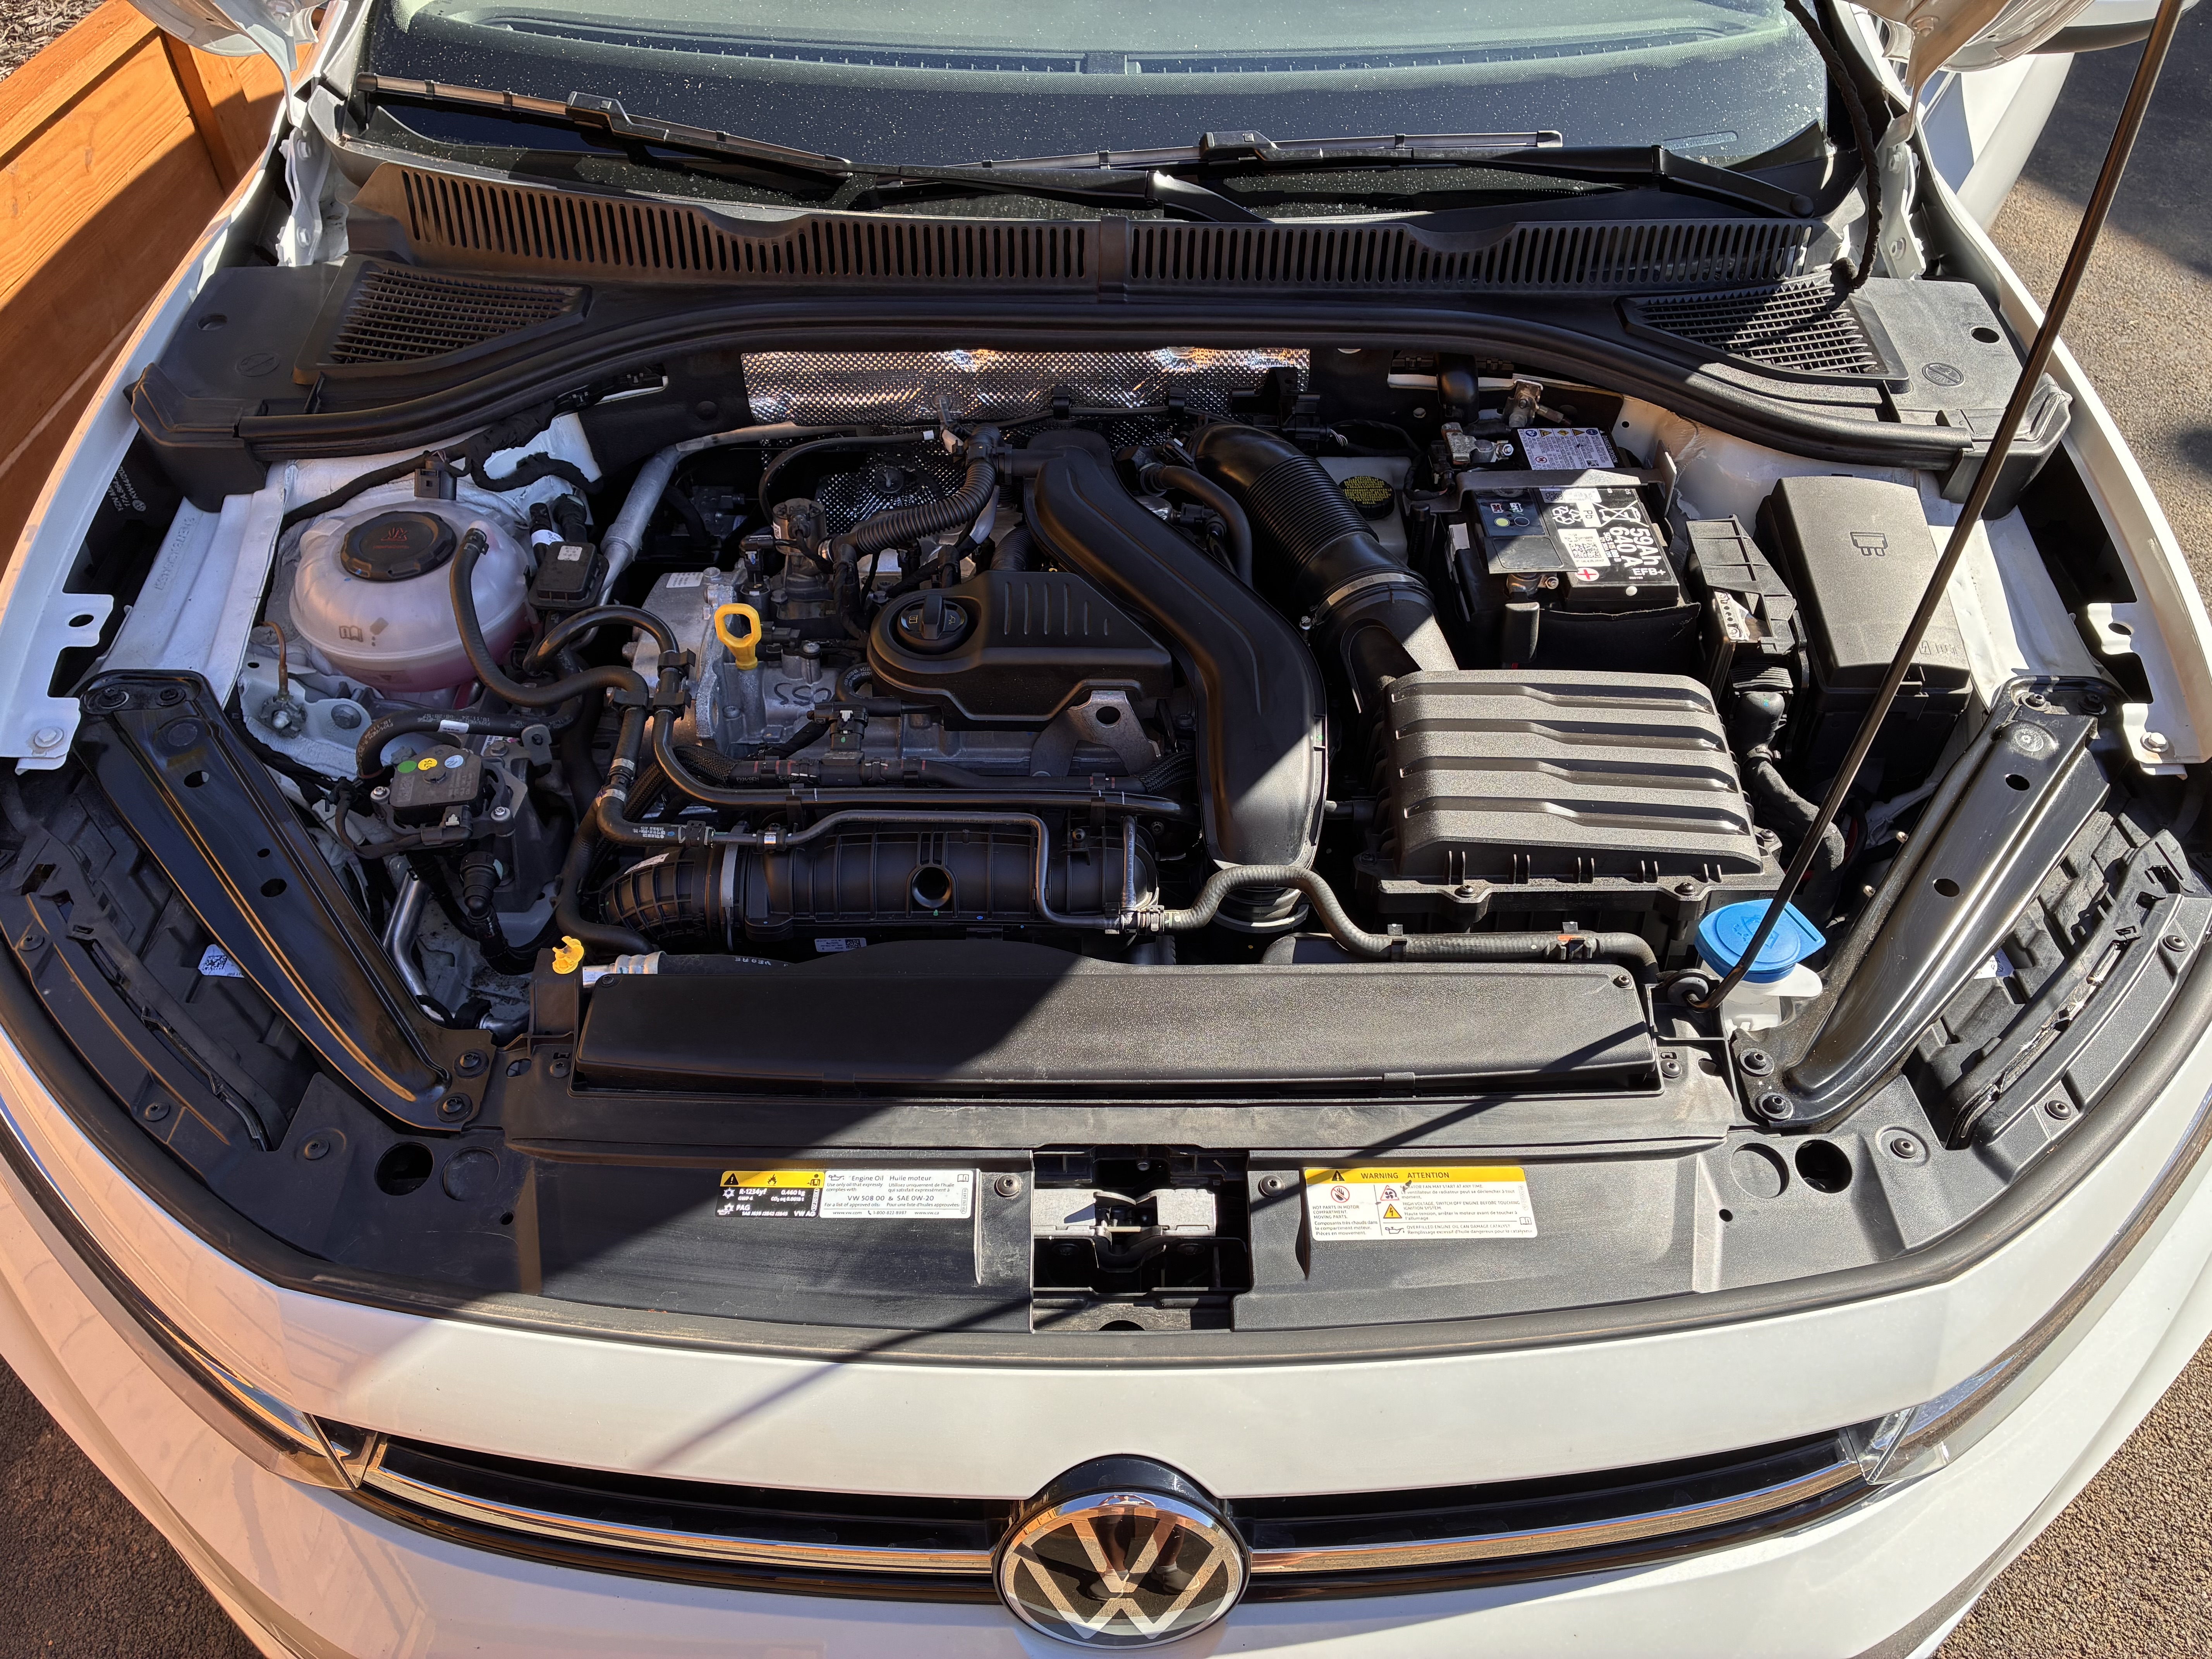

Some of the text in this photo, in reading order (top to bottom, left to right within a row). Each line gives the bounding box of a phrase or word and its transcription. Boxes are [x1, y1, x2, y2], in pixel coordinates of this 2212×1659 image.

[1585, 510, 1593, 519] Pb
[1609, 527, 1637, 552] 640
[1630, 528, 1662, 565] 59Ah
[1621, 555, 1643, 568] A
[1632, 568, 1666, 576] EFB+
[739, 1188, 767, 1197] R-1234yf
